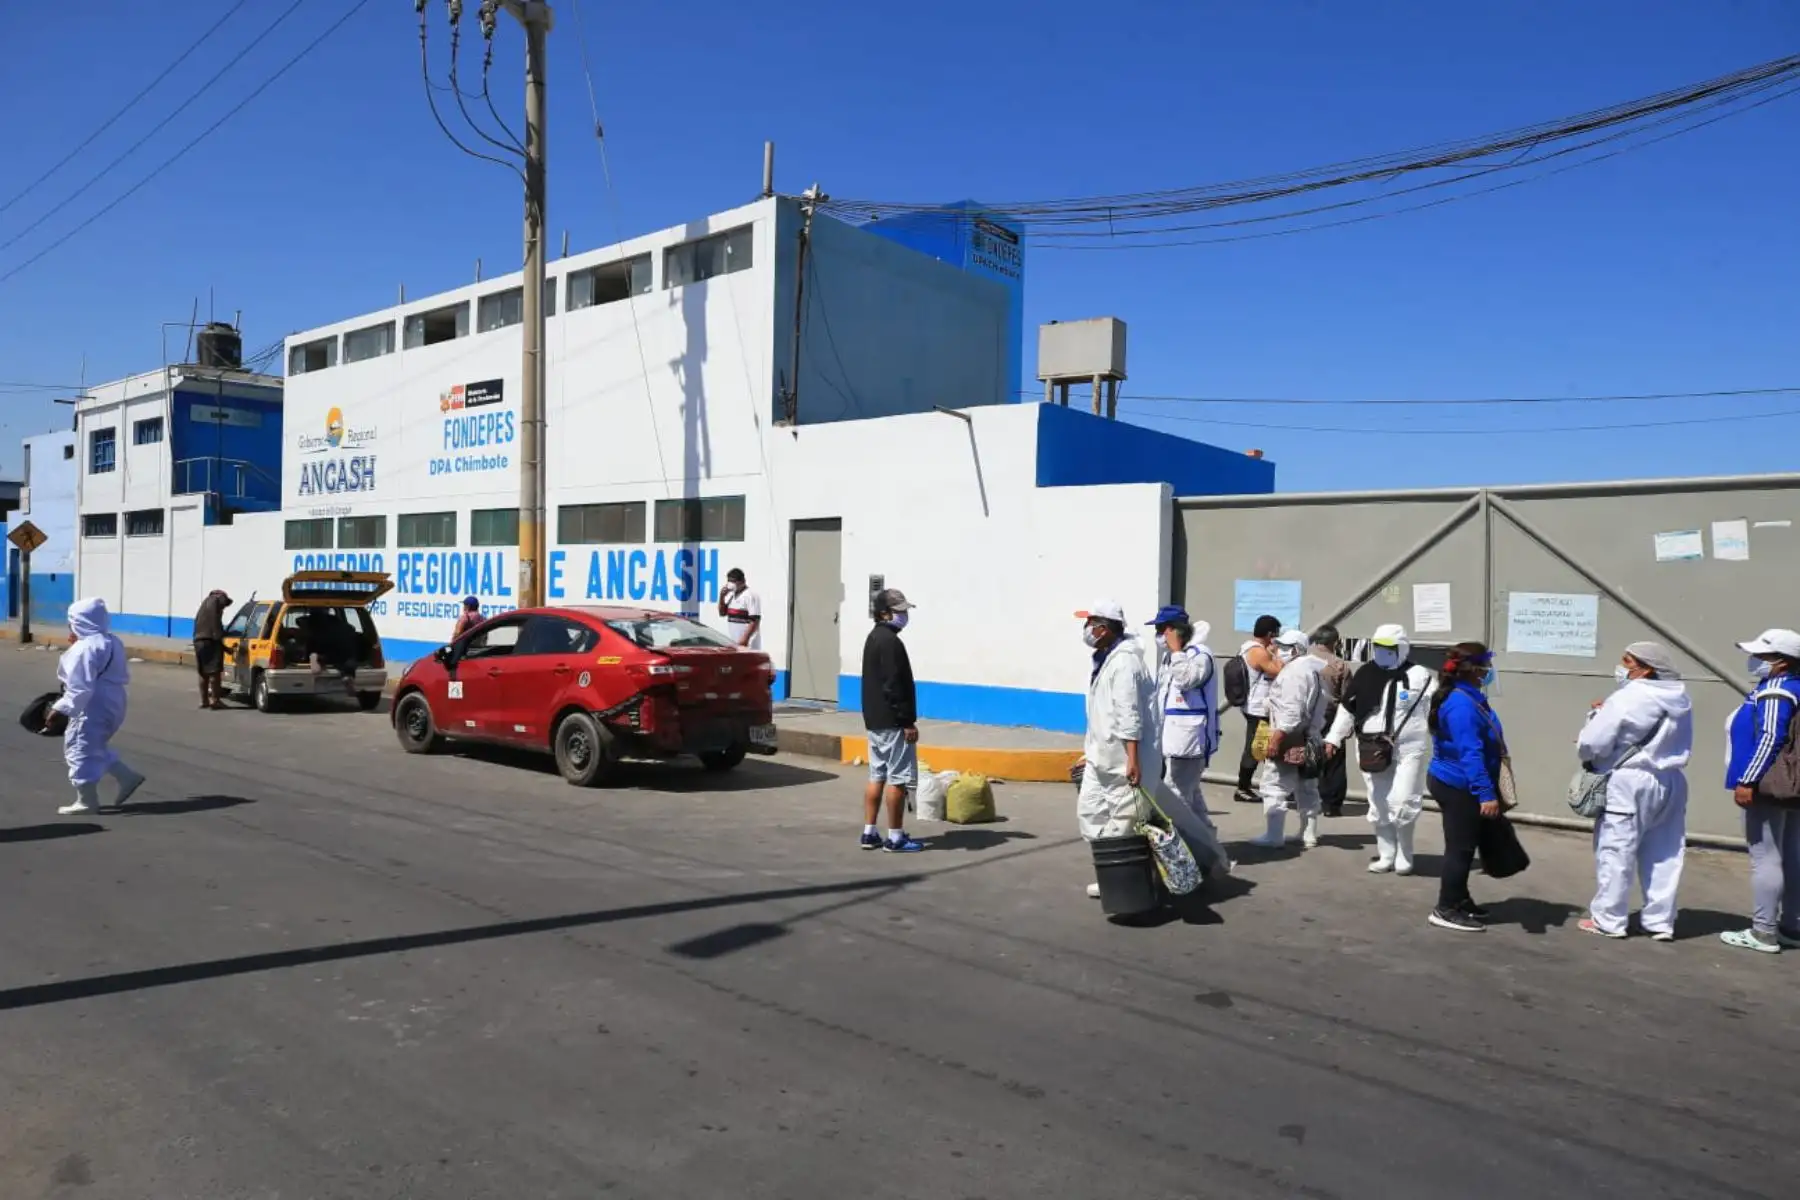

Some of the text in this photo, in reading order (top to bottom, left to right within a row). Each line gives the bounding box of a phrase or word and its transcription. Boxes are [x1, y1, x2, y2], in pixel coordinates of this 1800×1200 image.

[444, 411, 514, 450] FONDEPES
[298, 455, 377, 496] ANCASH
[430, 454, 508, 475] DPA Chimbote
[397, 552, 511, 597] REGIONAL
[586, 548, 719, 603] ANCASH
[397, 601, 460, 618] PESQUERO
